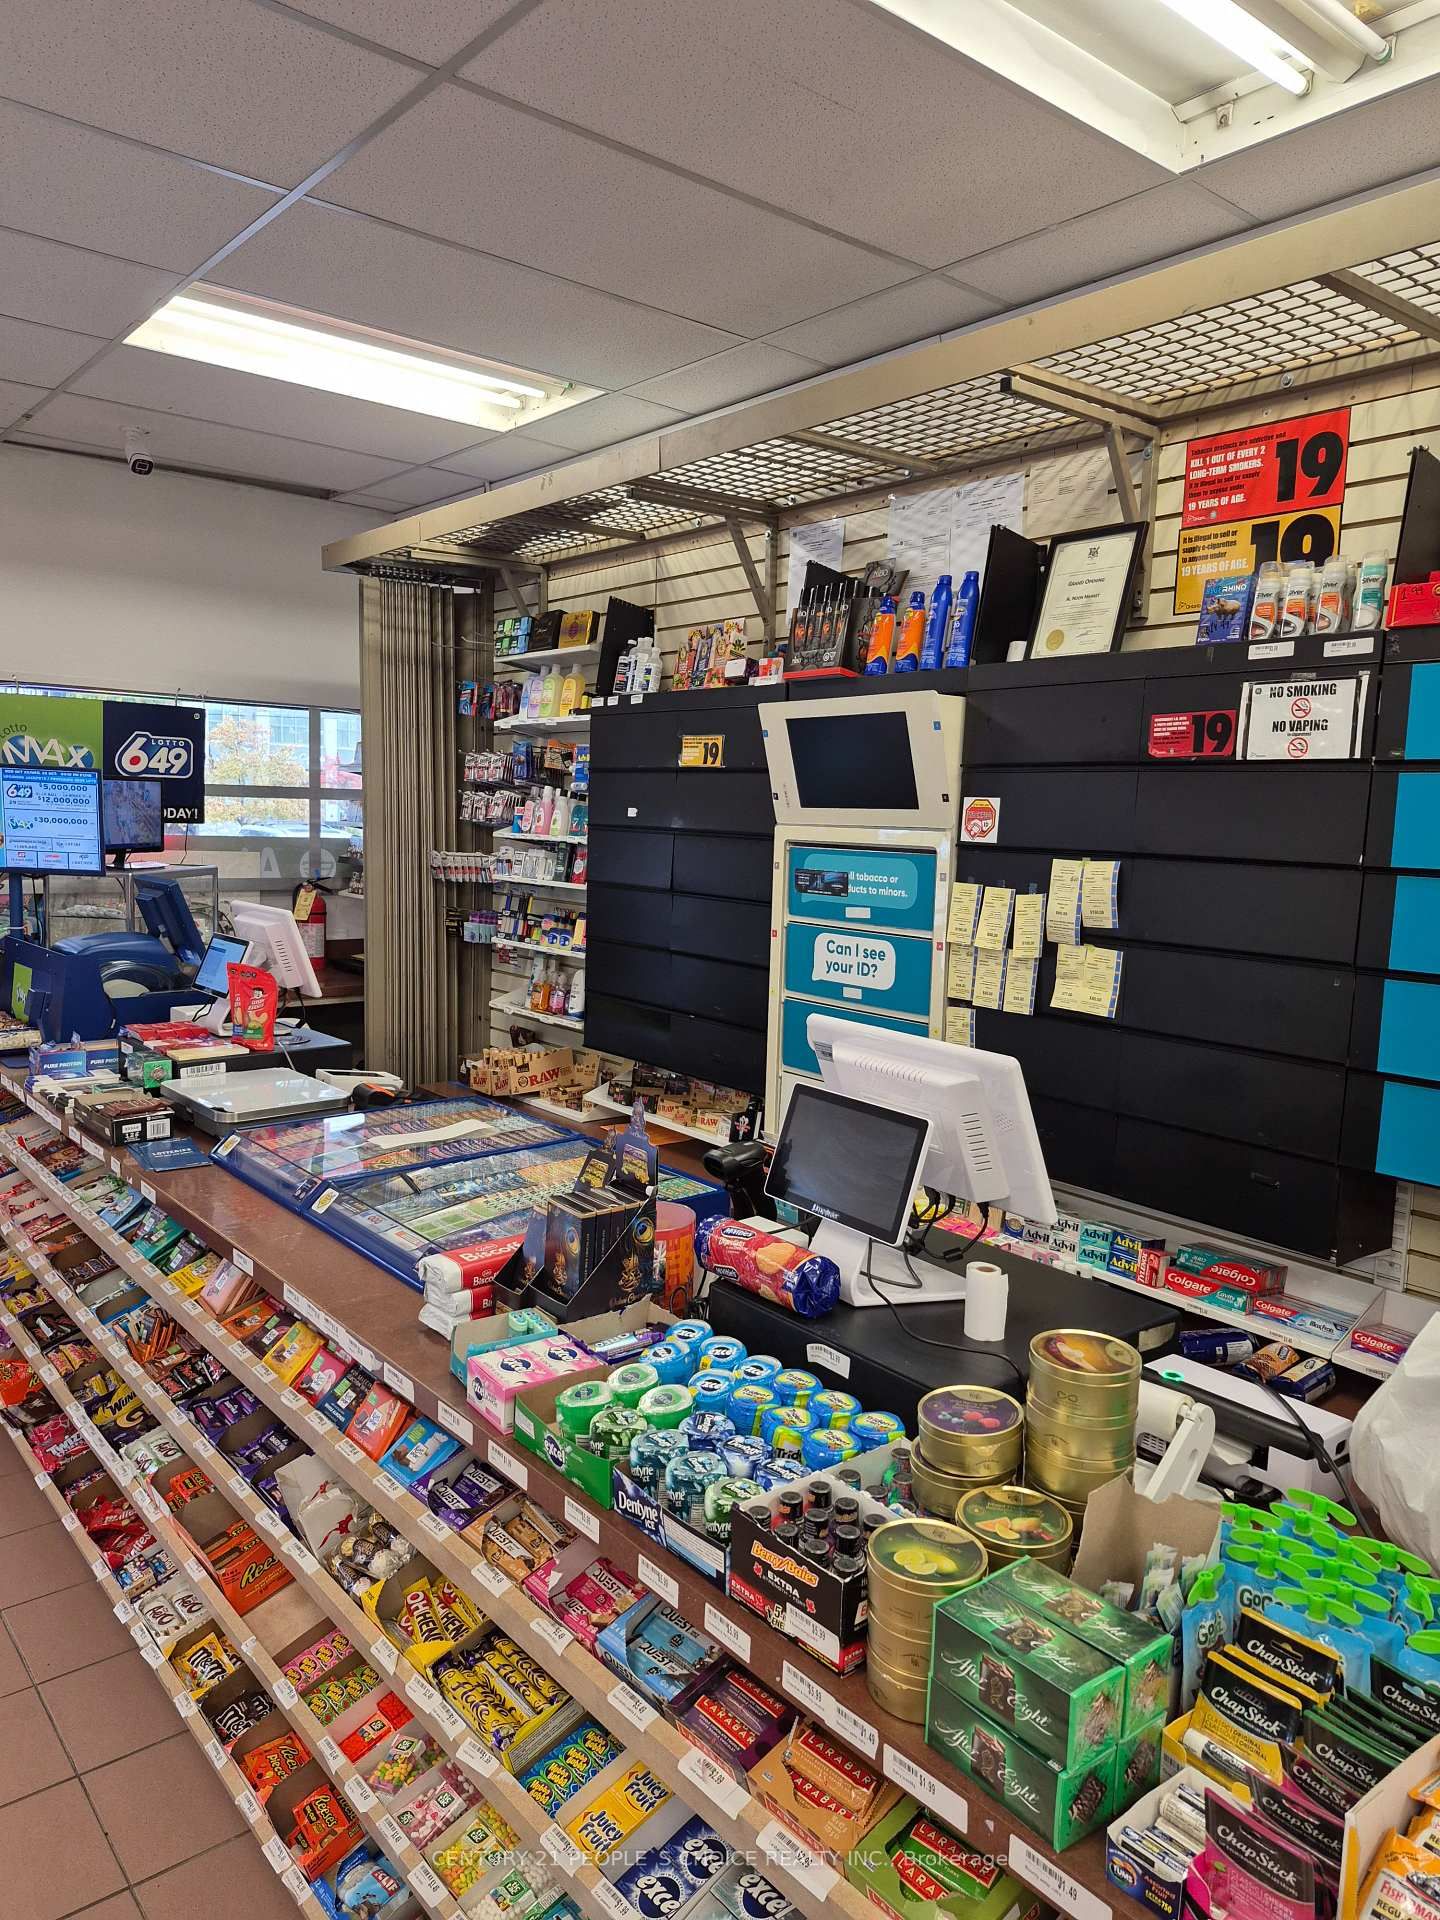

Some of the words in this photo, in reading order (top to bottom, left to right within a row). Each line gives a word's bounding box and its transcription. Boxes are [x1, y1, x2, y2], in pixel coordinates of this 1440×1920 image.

[1190, 458, 1204, 468] KILL
[1206, 456, 1210, 465] 1
[1211, 454, 1224, 464] OUT
[1226, 451, 1236, 460] OF
[1237, 447, 1258, 460] EVERY
[1260, 446, 1266, 454] 2
[1276, 432, 1344, 502] 19
[1190, 465, 1227, 480] LONG-TERM
[1228, 459, 1264, 472] SMOKERS.
[1188, 502, 1196, 511] 19
[1198, 498, 1219, 509] YEARS
[1220, 496, 1229, 505] OF
[1231, 493, 1246, 504] AGE.
[1220, 530, 1230, 538] sell
[1182, 545, 1201, 554] supply
[1202, 540, 1237, 552] e-cigarettes
[1182, 556, 1188, 564] to
[1188, 554, 1208, 563] anyone
[1210, 551, 1227, 560] under
[1182, 566, 1191, 577] 19
[1192, 563, 1217, 575] YEARS
[1220, 561, 1230, 571] OF
[1231, 558, 1248, 569] AGE.
[1222, 584, 1247, 592] RHINO
[1270, 686, 1284, 698] NO
[1286, 683, 1337, 697] SMOKING
[1192, 712, 1232, 753] 19
[1272, 721, 1286, 733] NO
[1289, 719, 1328, 732] VAPING
[121, 737, 189, 774] 649
[703, 742, 720, 764] 19
[40, 784, 88, 792] $5,000,000
[38, 796, 90, 805] $12,000,000
[34, 816, 88, 826] $30,000,000
[856, 872, 888, 883] tobacco
[890, 876, 898, 884] or
[868, 887, 877, 895] to
[878, 887, 908, 898] minors.
[826, 940, 852, 956] Can
[856, 944, 859, 956] I
[862, 949, 886, 961] see
[826, 960, 853, 974] your
[856, 961, 878, 978] ID?
[472, 1076, 487, 1085] RAW
[495, 1078, 509, 1090] RAW
[529, 1066, 561, 1087] RAW
[700, 1118, 718, 1127] RAW
[1056, 1218, 1079, 1232] Advil
[1082, 1228, 1109, 1242] Advil
[1025, 1229, 1050, 1244] Advil
[1051, 1237, 1076, 1252] Advil
[1114, 1234, 1142, 1250] Advil
[1081, 1248, 1106, 1263] Advil
[1110, 1256, 1137, 1272] Advil
[1167, 1273, 1214, 1294] Colgate
[1210, 1264, 1256, 1286] Colgate
[1256, 1300, 1292, 1317] Colgate
[1354, 1332, 1395, 1351] Colgate
[866, 1415, 896, 1426] Trident
[544, 1435, 565, 1463] excel
[467, 1468, 489, 1485] QUEST
[437, 1486, 462, 1508] QUEST
[618, 1491, 658, 1522] Dentyne
[644, 1519, 656, 1530] ICE
[720, 1531, 729, 1539] ICE
[488, 1525, 516, 1552] QUEST
[752, 1540, 818, 1586] Berry/Baies
[593, 1568, 618, 1591] QUEST
[767, 1570, 800, 1598] EXTRA
[407, 1591, 429, 1611] OH
[731, 1580, 755, 1601] EXTRA
[662, 1606, 693, 1632] QUEST
[812, 1623, 826, 1641] $5.99
[640, 1641, 671, 1668] QUEST
[1247, 1638, 1319, 1686] ChapStick
[508, 1650, 547, 1686] Flake
[604, 1651, 634, 1682] QUEST
[940, 1652, 986, 1691] After
[498, 1663, 531, 1698] Flake
[808, 1687, 822, 1702] $5.99
[703, 1697, 756, 1744] LARABAR
[1006, 1688, 1053, 1736] Eight
[1210, 1686, 1281, 1736] ChapStick
[861, 1727, 875, 1745] $1.49
[934, 1719, 978, 1762] After
[809, 1735, 873, 1785] LARABAR
[635, 1770, 668, 1800] Juicy
[709, 1770, 725, 1785] $2.99
[919, 1774, 936, 1796] $1.99
[624, 1782, 657, 1813] Fruit
[790, 1770, 847, 1816] LARABAR
[997, 1762, 1040, 1815] Eight
[590, 1811, 624, 1842] Juicy
[1262, 1796, 1342, 1850] ChapStick
[578, 1823, 612, 1855] Fruit
[919, 1823, 990, 1876] LARABAR
[1217, 1825, 1297, 1885] ChapStick
[1113, 1865, 1134, 1884] TUMS
[637, 1875, 681, 1914] exce
[740, 1874, 796, 1915] excel
[1058, 1878, 1078, 1901] $1.49
[614, 1900, 630, 1916] $1.99
